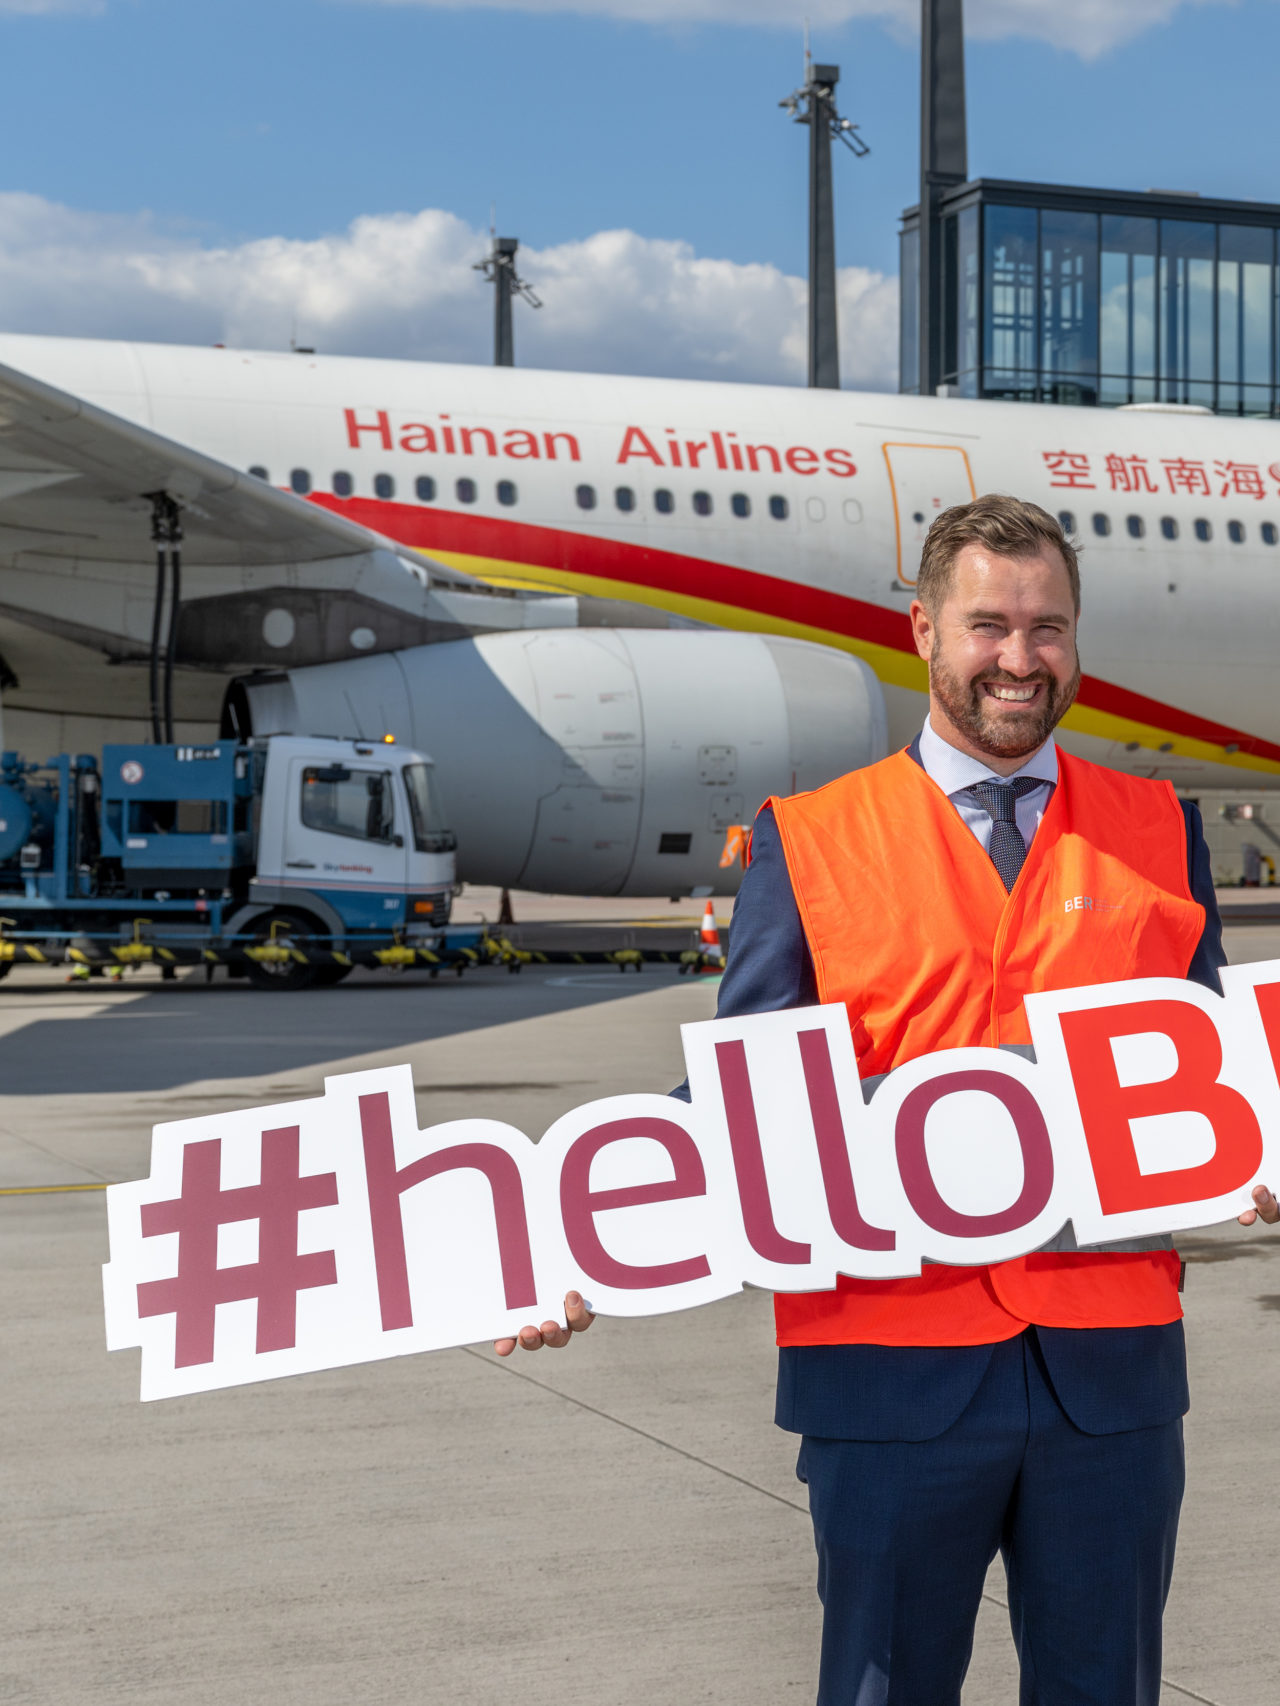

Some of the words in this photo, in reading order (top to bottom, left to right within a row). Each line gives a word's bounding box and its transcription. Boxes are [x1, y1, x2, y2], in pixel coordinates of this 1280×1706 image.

[344, 408, 580, 462] Hainan
[617, 425, 857, 478] Airlines
[1064, 896, 1094, 913] BER
